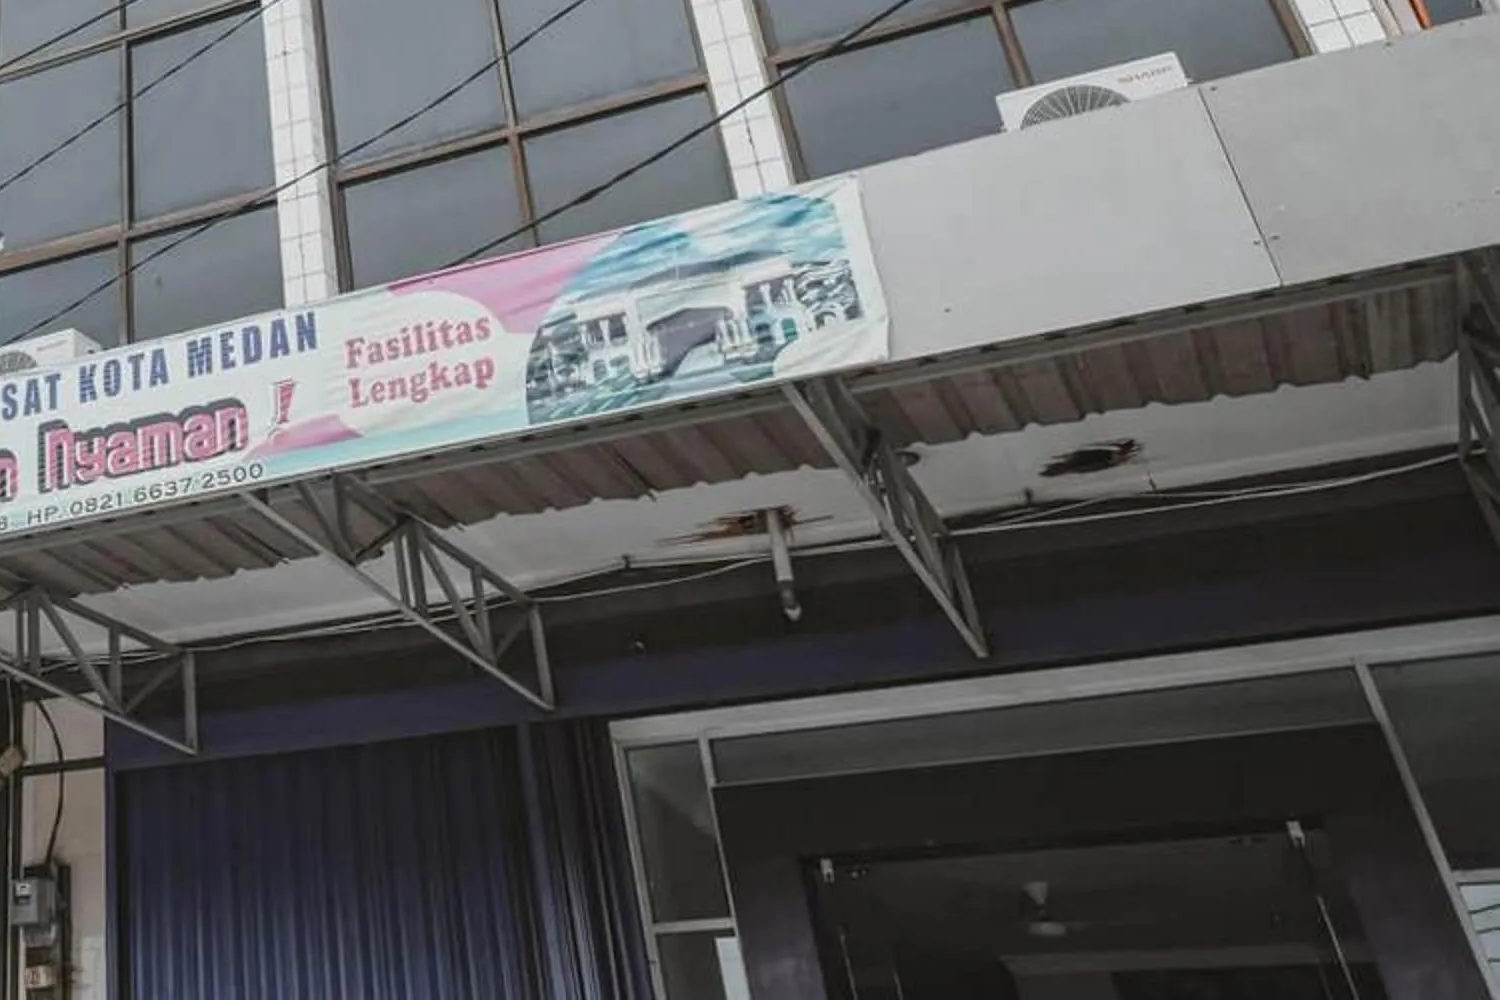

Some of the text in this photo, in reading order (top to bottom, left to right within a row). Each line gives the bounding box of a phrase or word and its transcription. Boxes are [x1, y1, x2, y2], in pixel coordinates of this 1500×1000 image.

[78, 347, 169, 404] KOTA
[186, 311, 318, 379] MEDAN
[345, 316, 492, 369] Fasilitas
[348, 356, 495, 408] Lengkap
[69, 492, 123, 516] 0821
[133, 477, 193, 502] 6637
[200, 463, 264, 490] 2500
